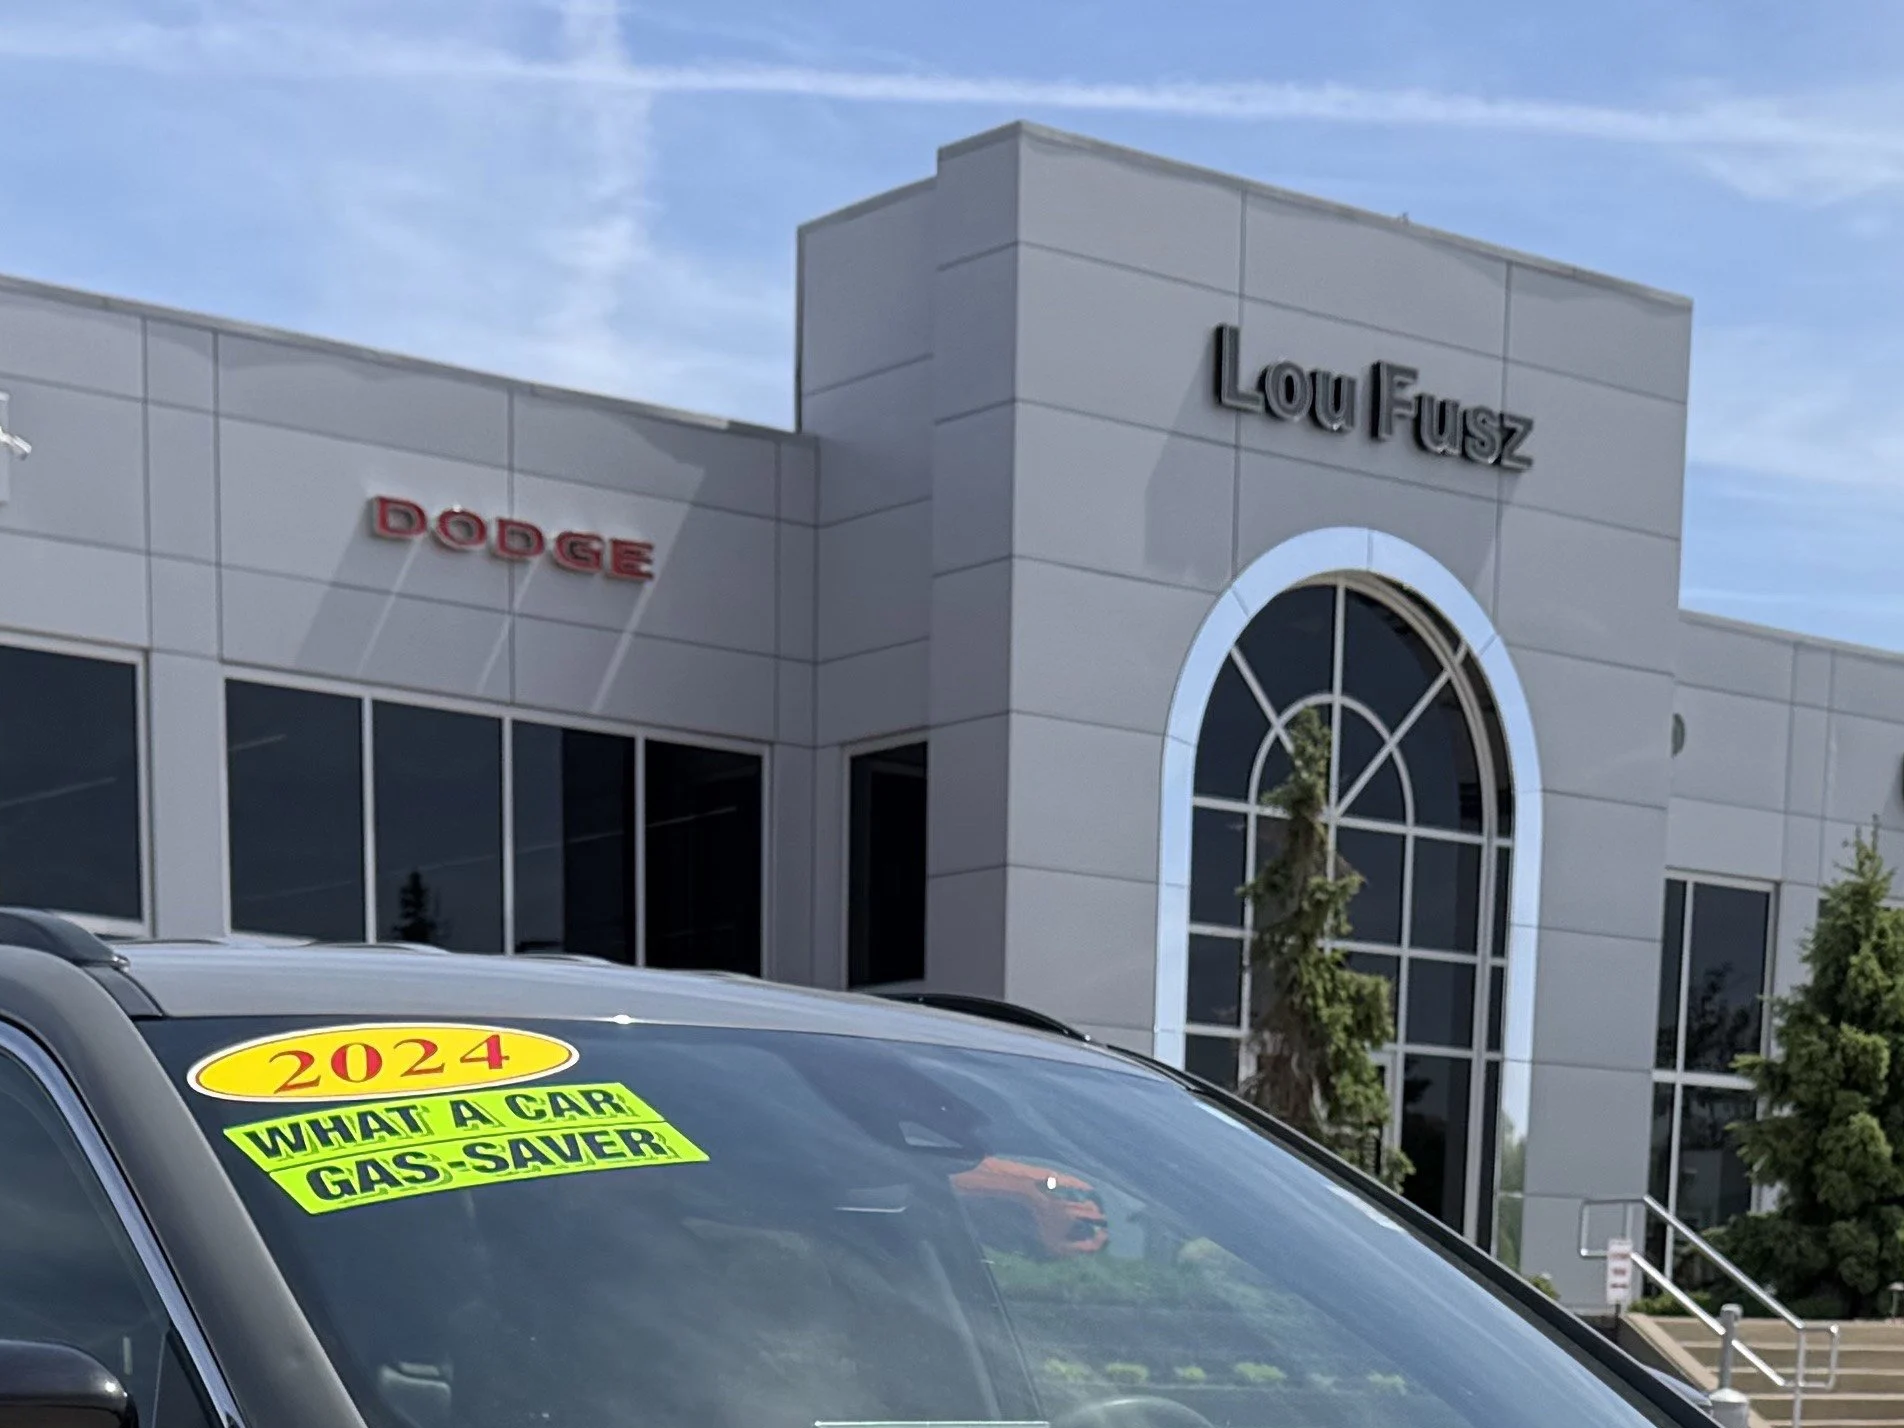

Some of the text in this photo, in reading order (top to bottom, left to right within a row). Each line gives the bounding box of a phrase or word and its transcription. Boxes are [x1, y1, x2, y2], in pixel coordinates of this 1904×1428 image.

[1213, 322, 1534, 472] Lou Fusz
[366, 494, 654, 582] DODGE
[268, 1033, 511, 1095] 2024
[247, 1087, 631, 1161] WHAT A CAR
[304, 1126, 671, 1203] GAS-SAVER
